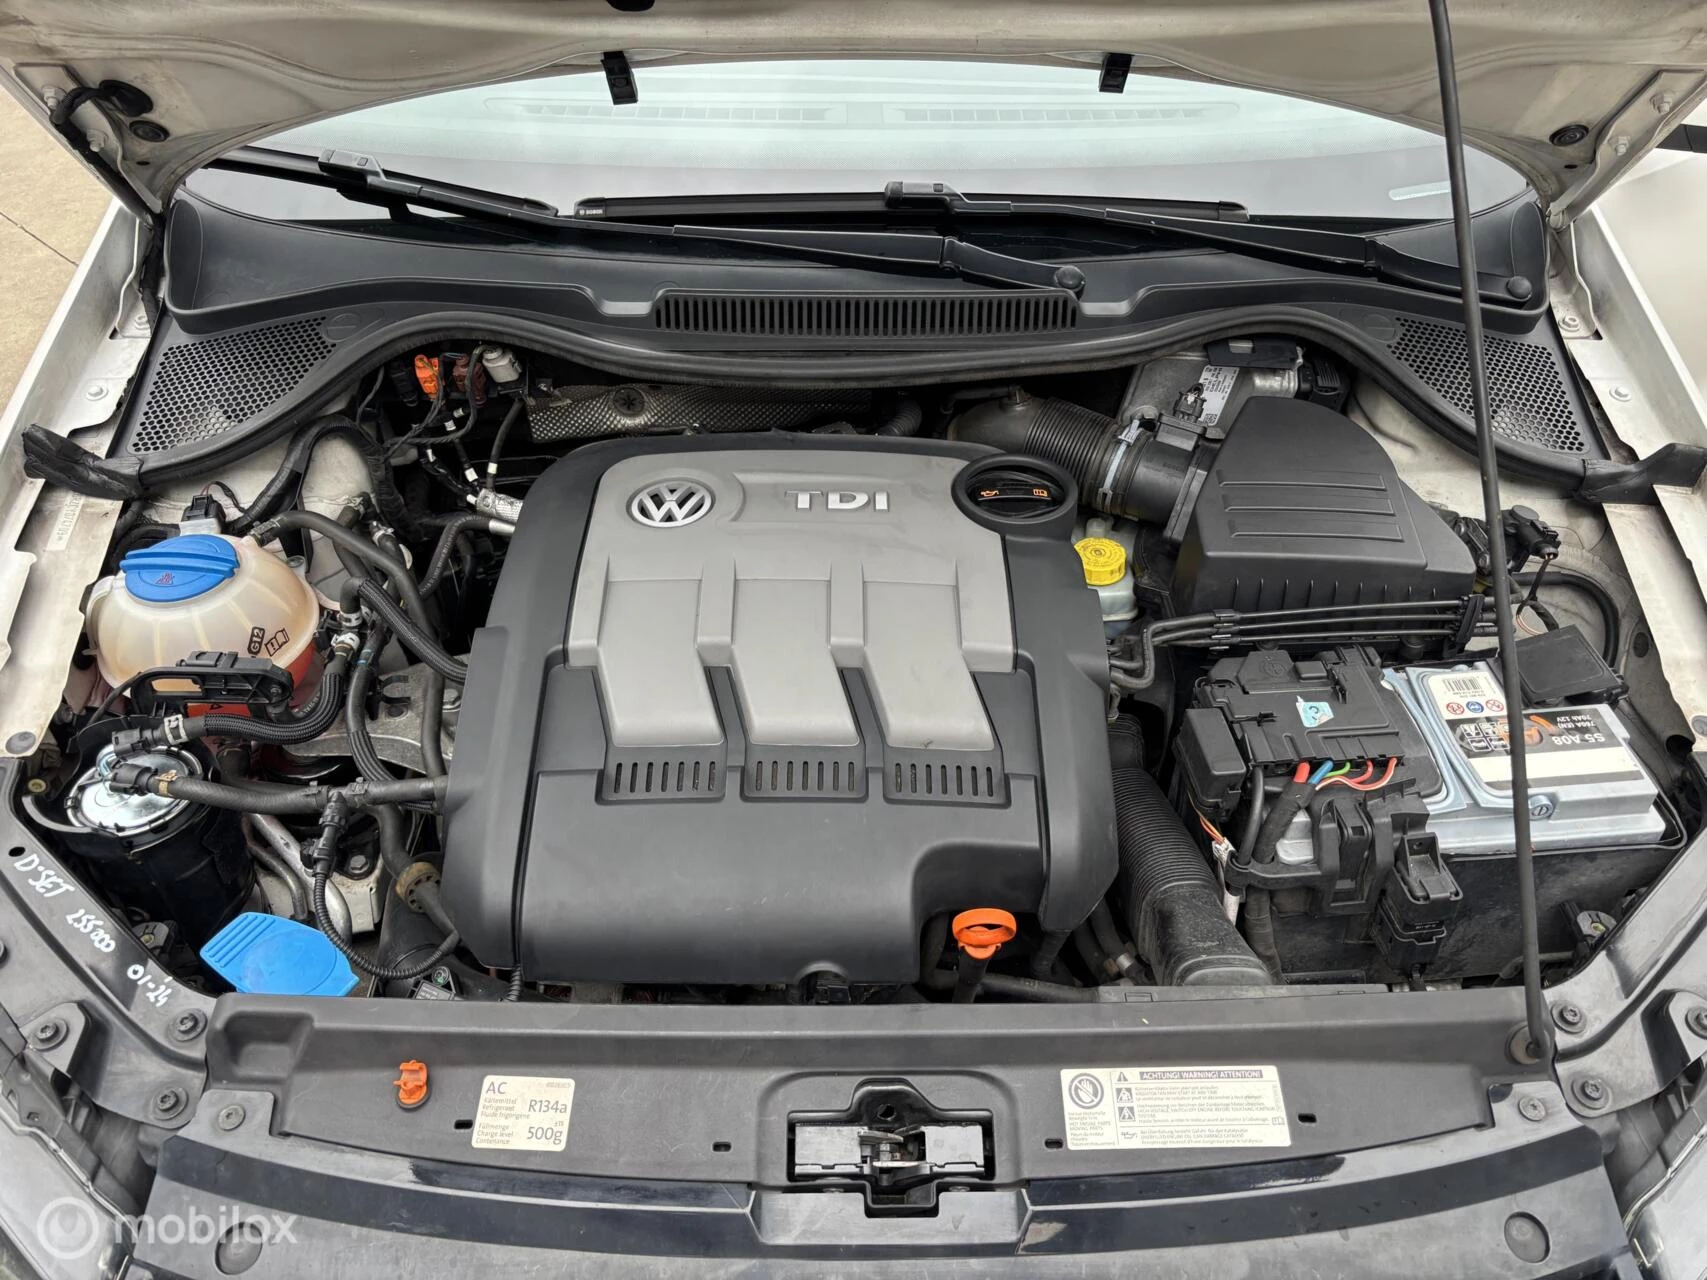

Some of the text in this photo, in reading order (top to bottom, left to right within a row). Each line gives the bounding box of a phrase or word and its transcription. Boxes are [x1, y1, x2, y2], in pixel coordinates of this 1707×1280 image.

[784, 490, 890, 511] TDI
[250, 629, 263, 652] G12
[1584, 733, 1606, 743] S5
[1142, 1070, 1261, 1079] ACHTUNG! WARNING! ATTENTION!
[485, 1081, 508, 1095] AC
[528, 1099, 568, 1113] R134a
[527, 1126, 563, 1145] 500g
